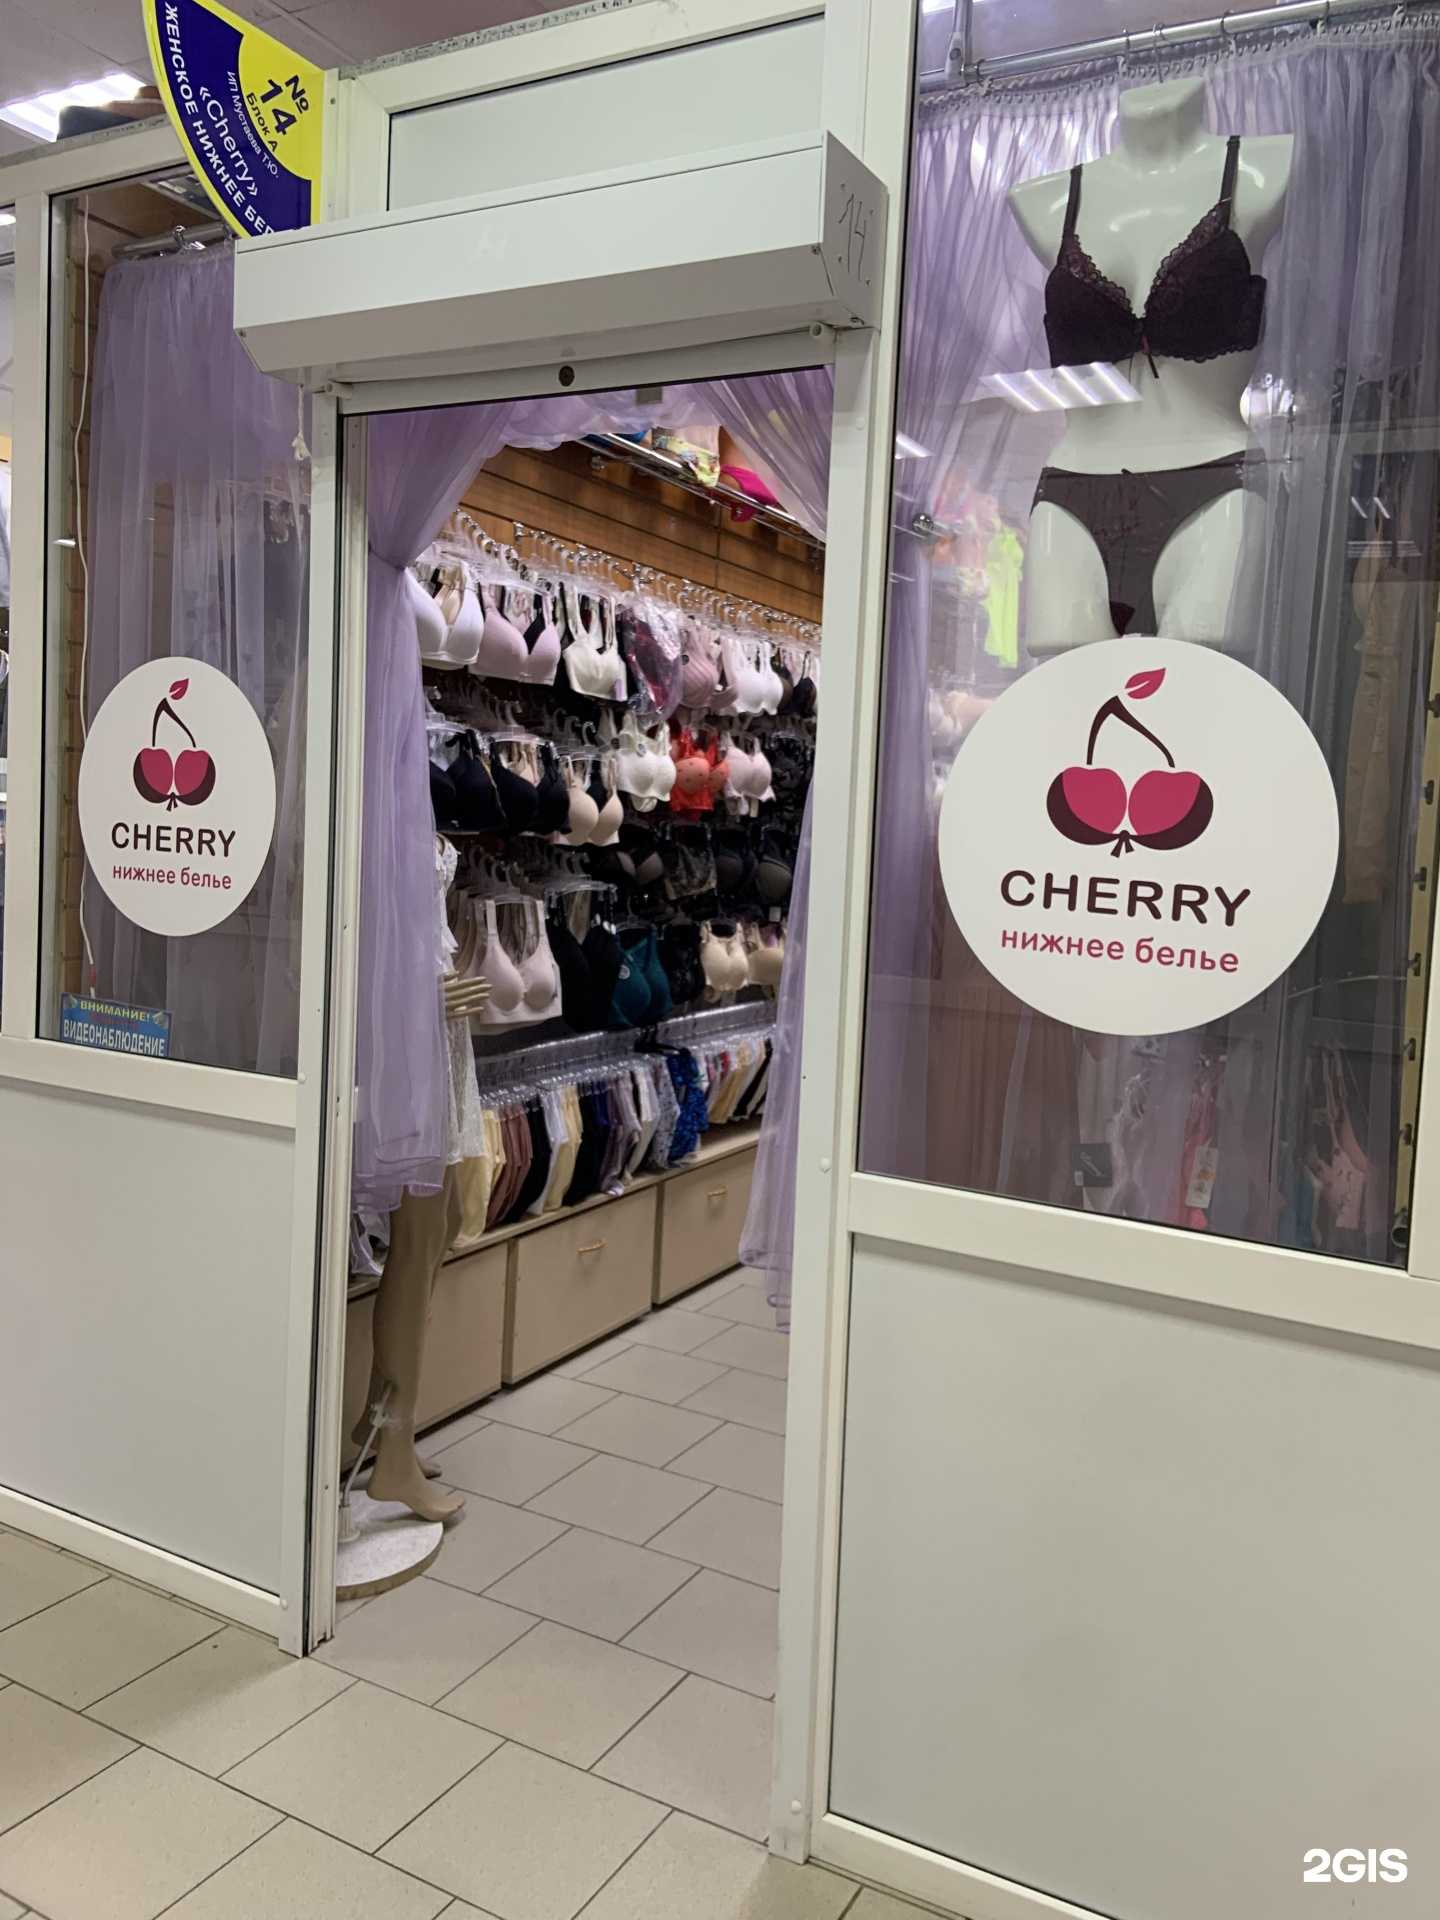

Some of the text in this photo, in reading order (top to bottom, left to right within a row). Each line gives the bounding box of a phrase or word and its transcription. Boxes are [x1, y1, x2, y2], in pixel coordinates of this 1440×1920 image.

[226, 71, 239, 92] ИП
[285, 75, 309, 114] №
[165, 2, 199, 115] ЖЕНСКОЕ
[192, 120, 245, 207] НИЖНЕЕ
[246, 92, 279, 153] Блок А
[259, 79, 298, 136] 14
[199, 86, 258, 196] «Cherry»
[838, 193, 867, 282] 14
[111, 822, 236, 858] CHERRY
[113, 865, 232, 890] нижнее белье
[1000, 869, 1251, 927] CHERRY
[1001, 929, 1240, 973] нижнее белье
[79, 1000, 150, 1022] ВНИМАНИЕ!
[63, 1019, 166, 1057] ВИДЕОНАБЛЮДЕНИЕ
